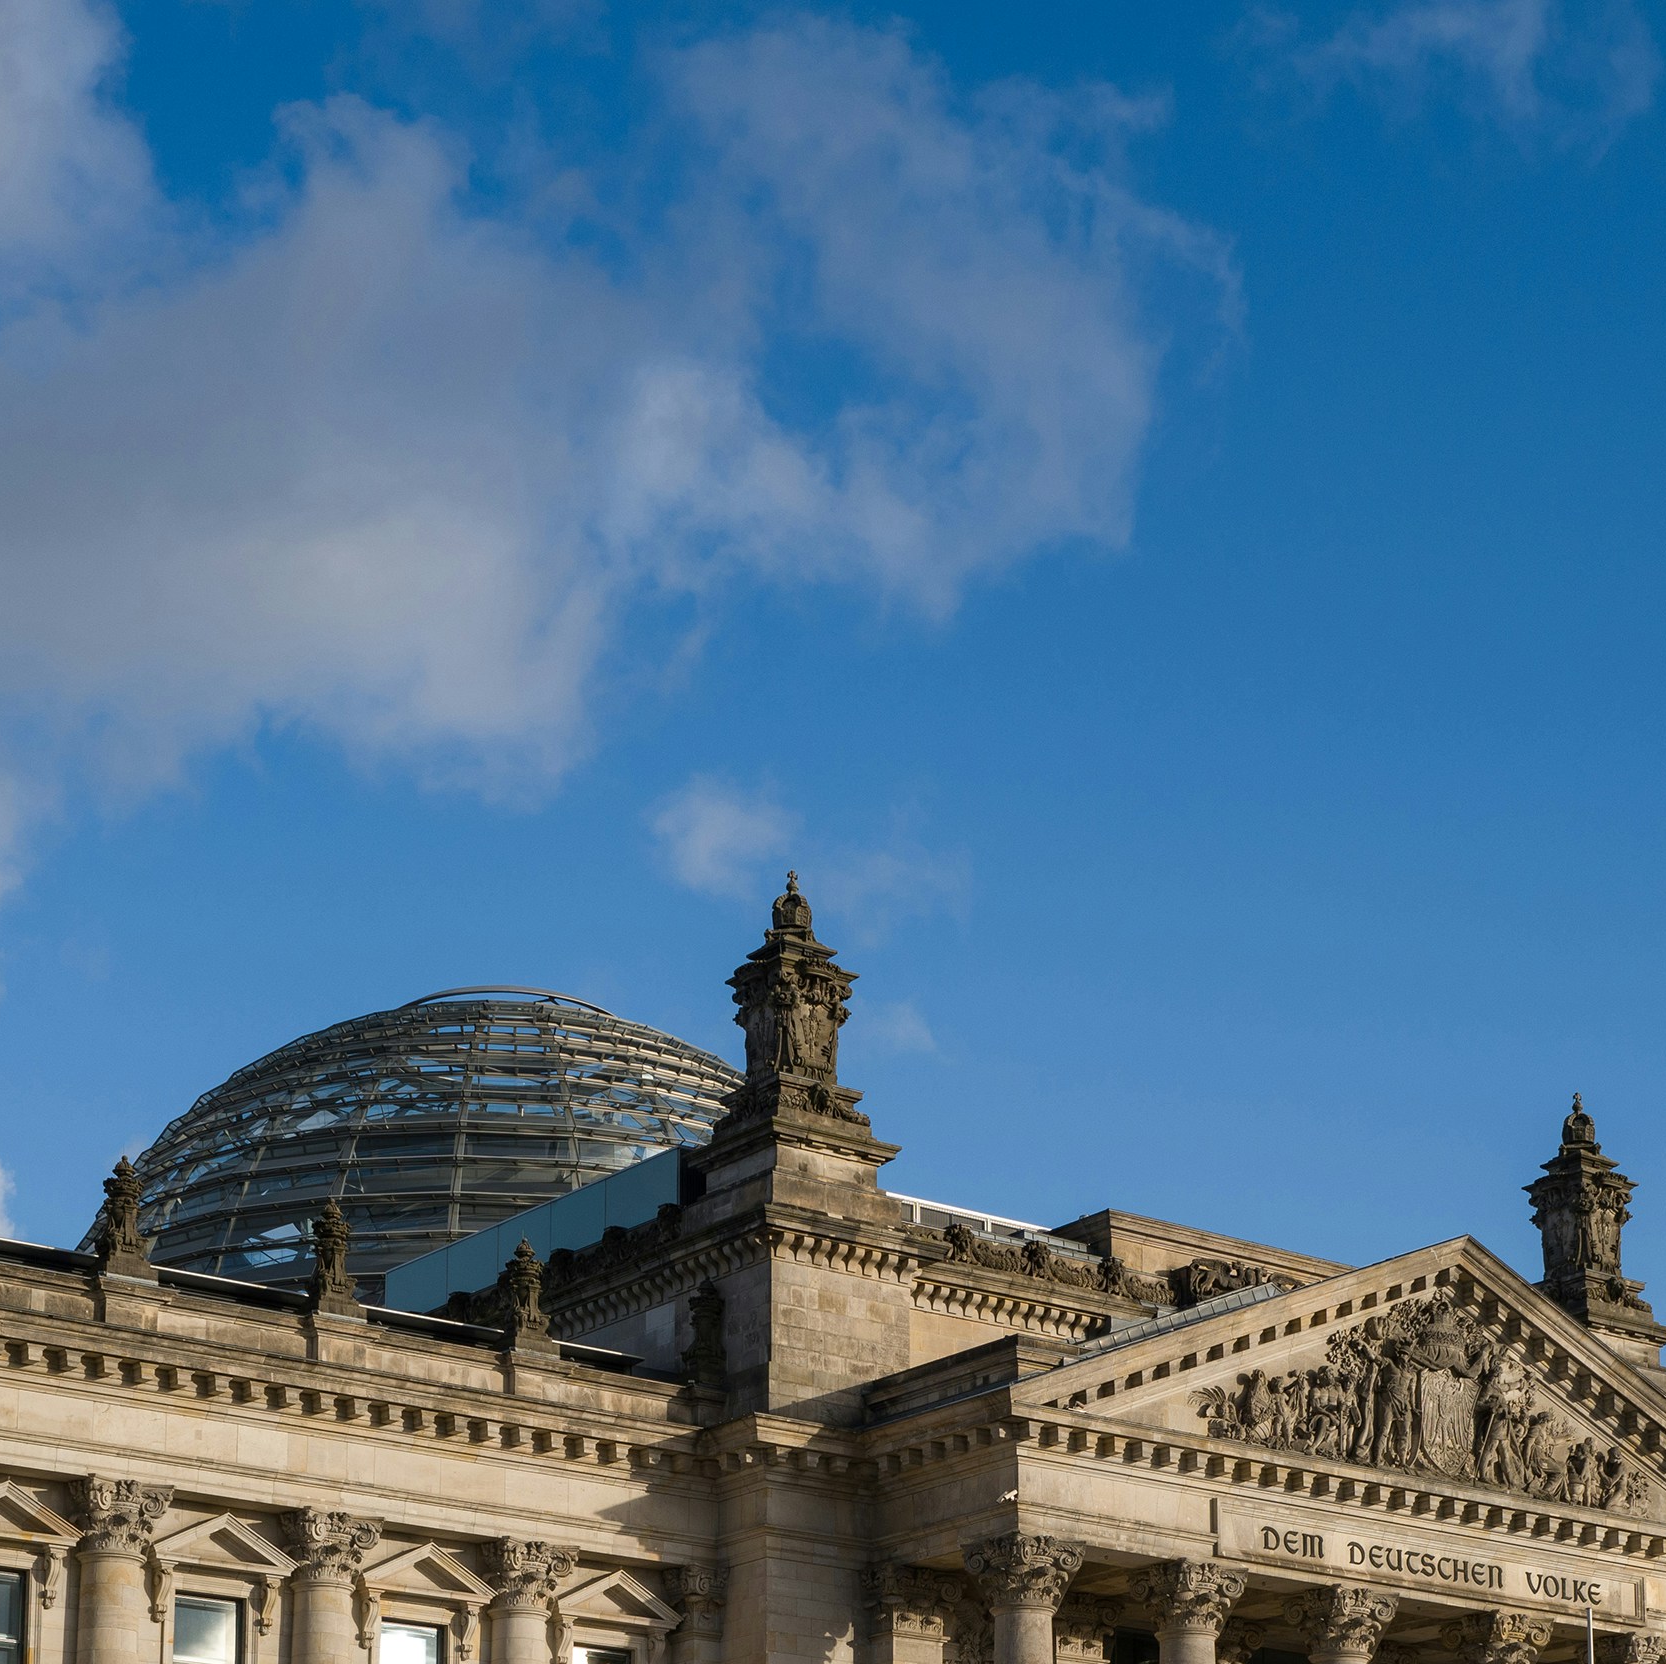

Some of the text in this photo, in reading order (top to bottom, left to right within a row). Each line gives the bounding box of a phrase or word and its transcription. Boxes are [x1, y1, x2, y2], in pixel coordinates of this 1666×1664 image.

[1261, 1526, 1602, 1605] DEM DEUTSCHEN VOLKE
